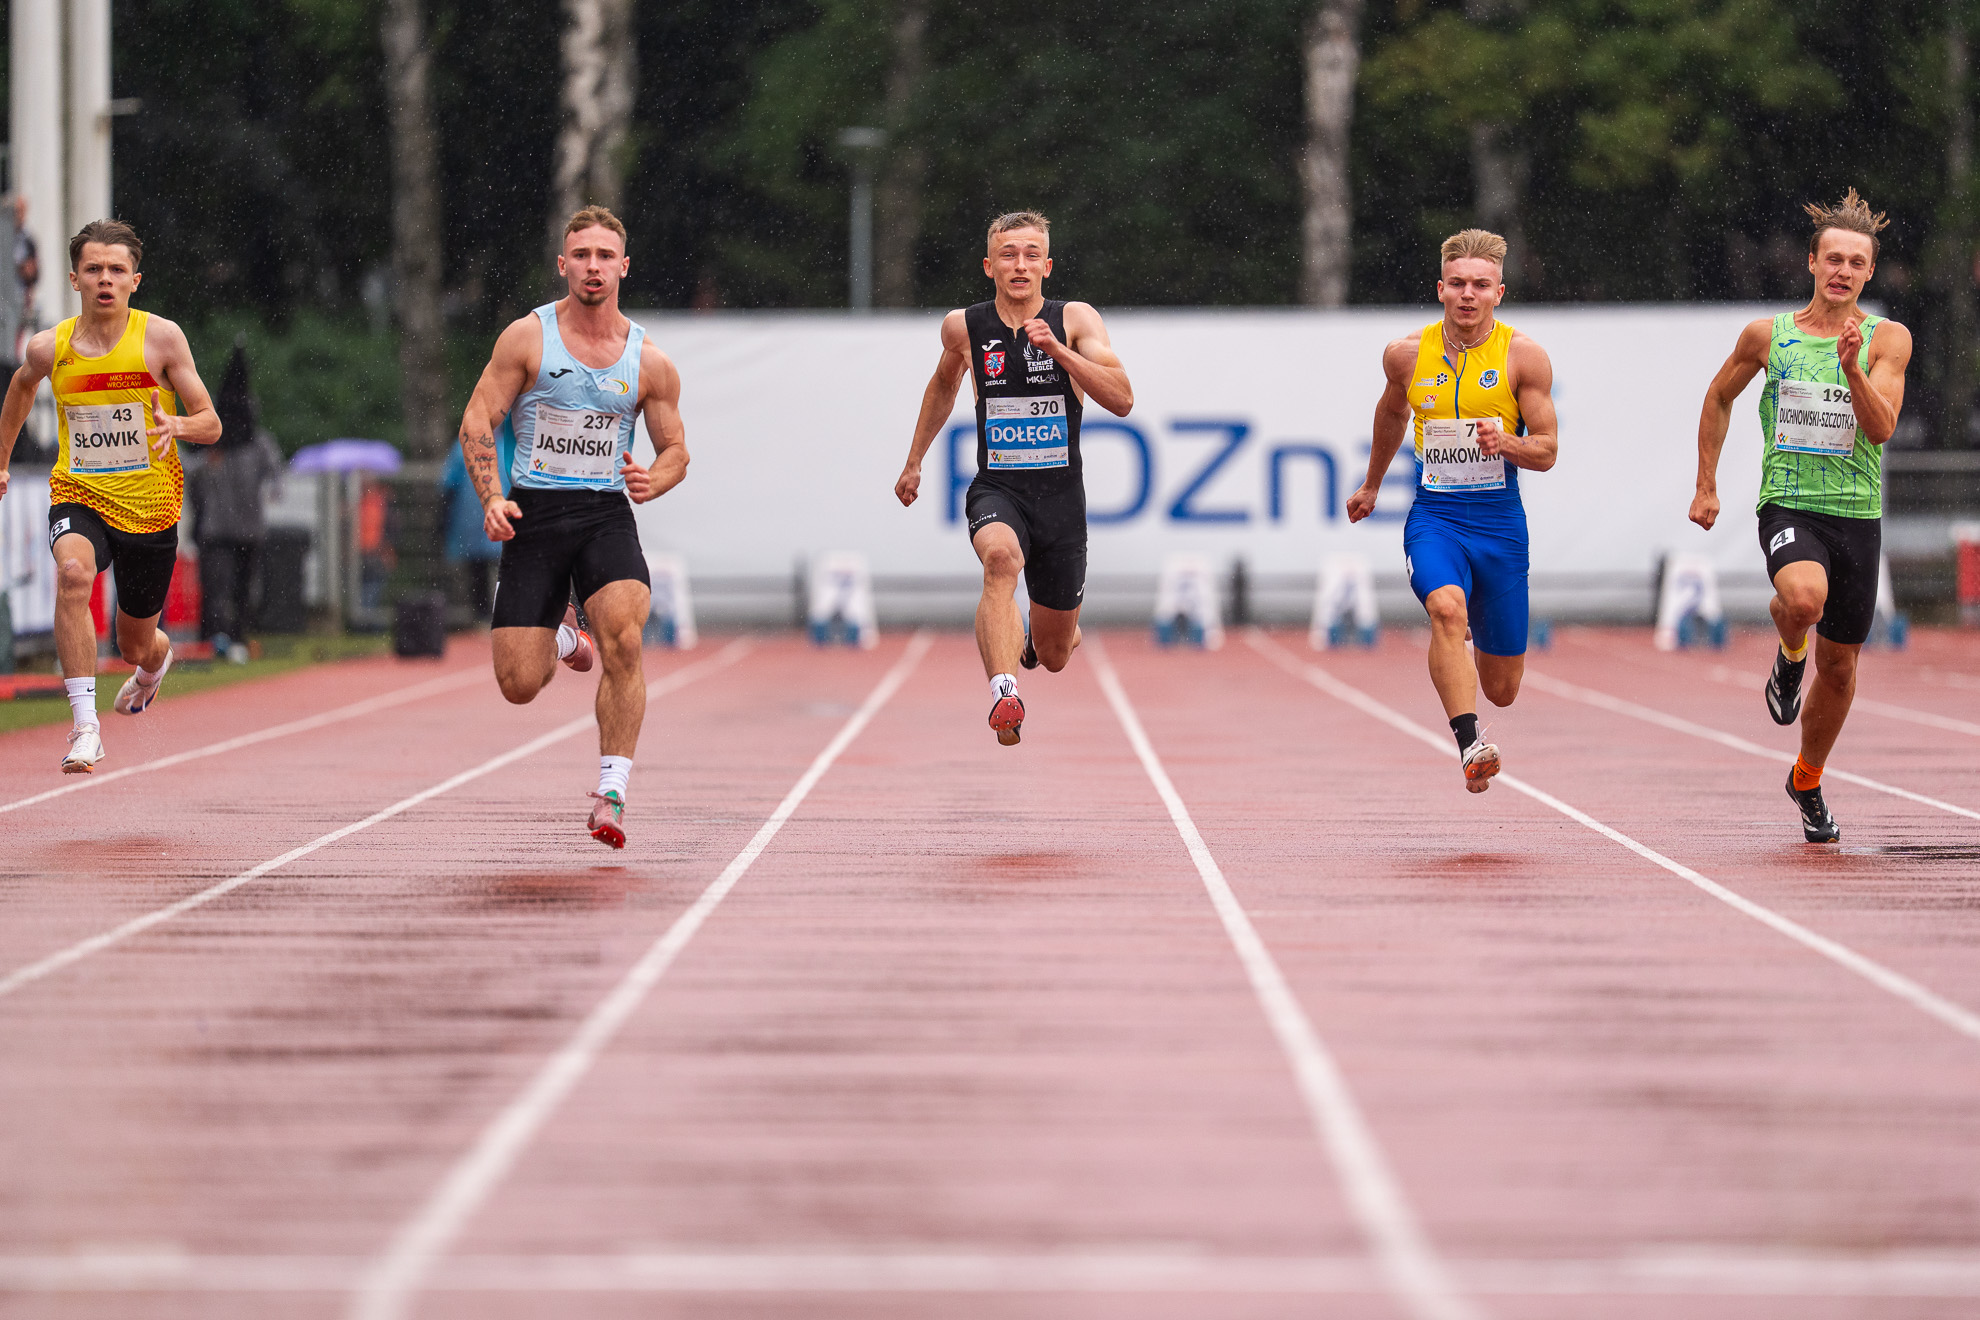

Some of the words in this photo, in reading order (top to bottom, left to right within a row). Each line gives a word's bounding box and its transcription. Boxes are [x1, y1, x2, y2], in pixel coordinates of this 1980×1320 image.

[1028, 365, 1054, 373] SIEDLCE
[106, 380, 142, 388] WROCŁAW
[109, 374, 123, 382] MKS
[124, 373, 142, 381] MOS
[1823, 388, 1852, 403] 196
[112, 408, 132, 422] 43
[1030, 400, 1059, 416] 370
[583, 415, 615, 430] 237
[1779, 407, 1855, 430] DUCHNOWSKI-SZCZOTKA
[75, 430, 140, 448] SŁOWIK
[991, 424, 1062, 446] DOŁĘGA
[536, 434, 613, 457] JASIŃSKI
[1773, 530, 1789, 547] 4
